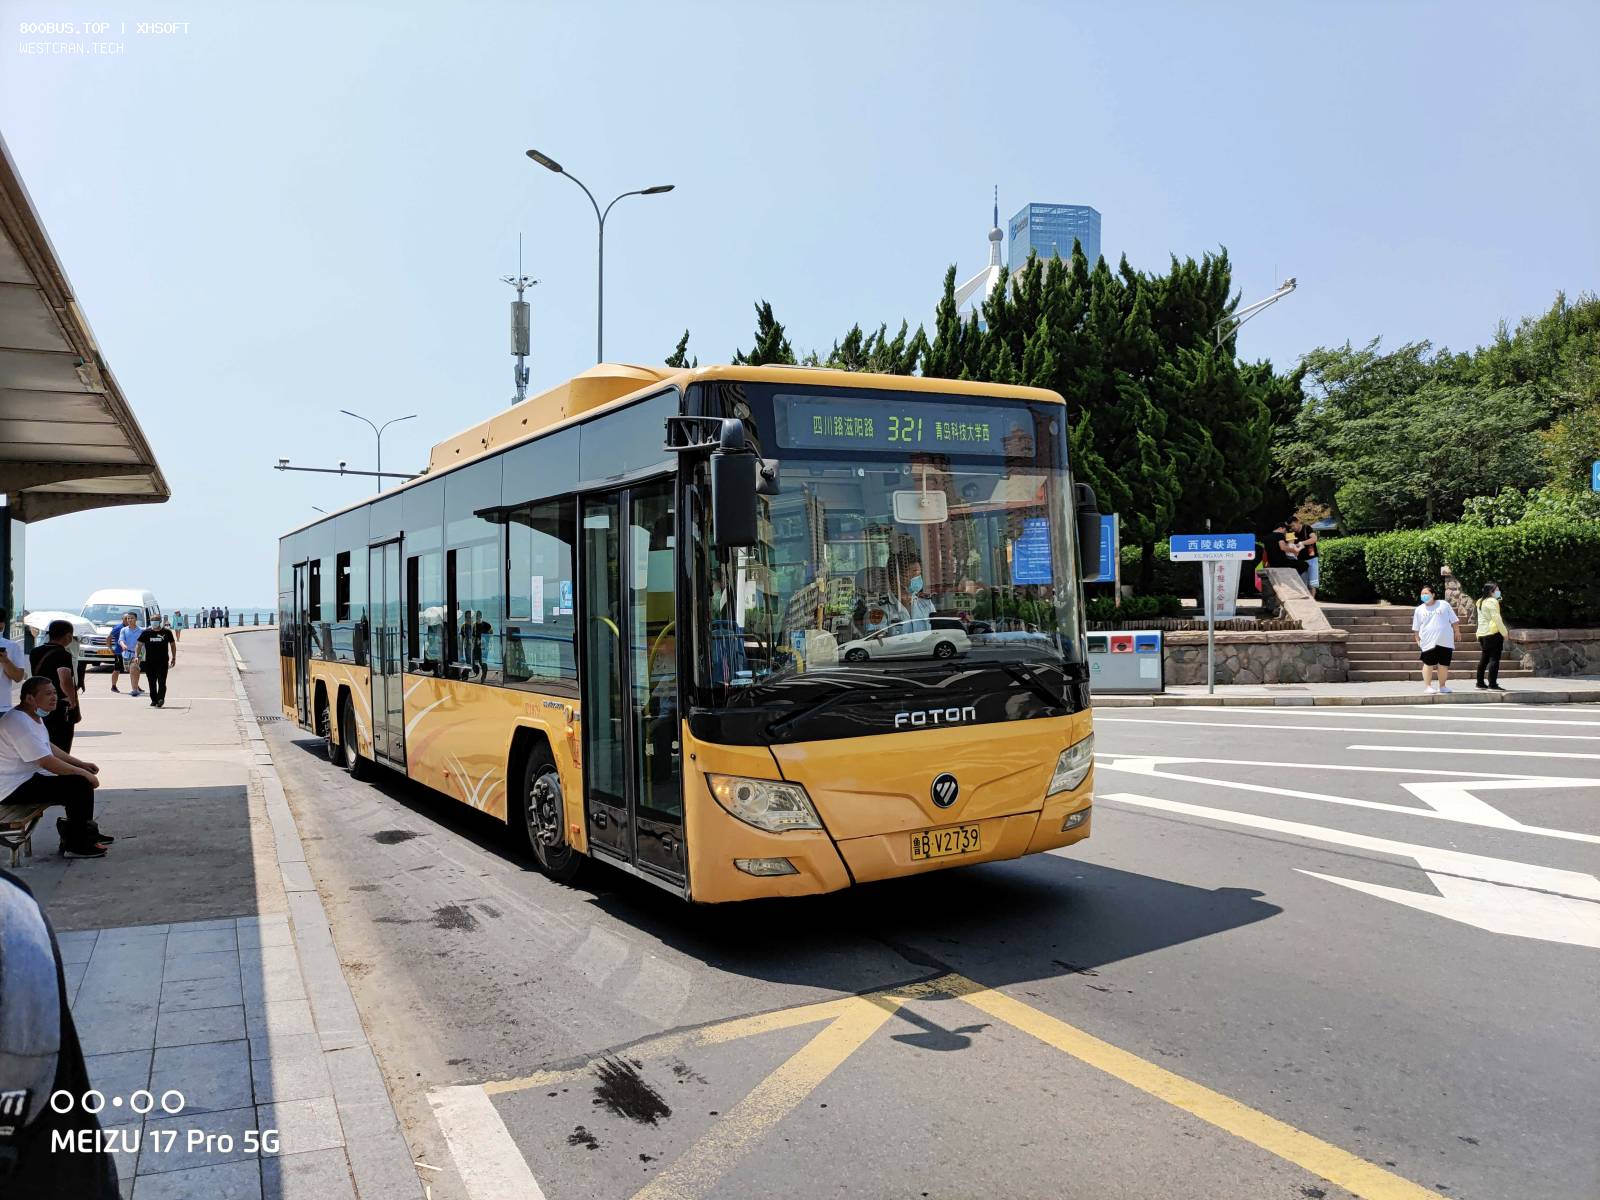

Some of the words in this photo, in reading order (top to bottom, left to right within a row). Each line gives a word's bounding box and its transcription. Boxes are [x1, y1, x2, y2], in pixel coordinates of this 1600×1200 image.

[887, 416, 923, 442] 321
[935, 421, 990, 442] 青岛科技大学西
[1187, 538, 1238, 550] 西陵峡路
[894, 706, 976, 728] FOTON
